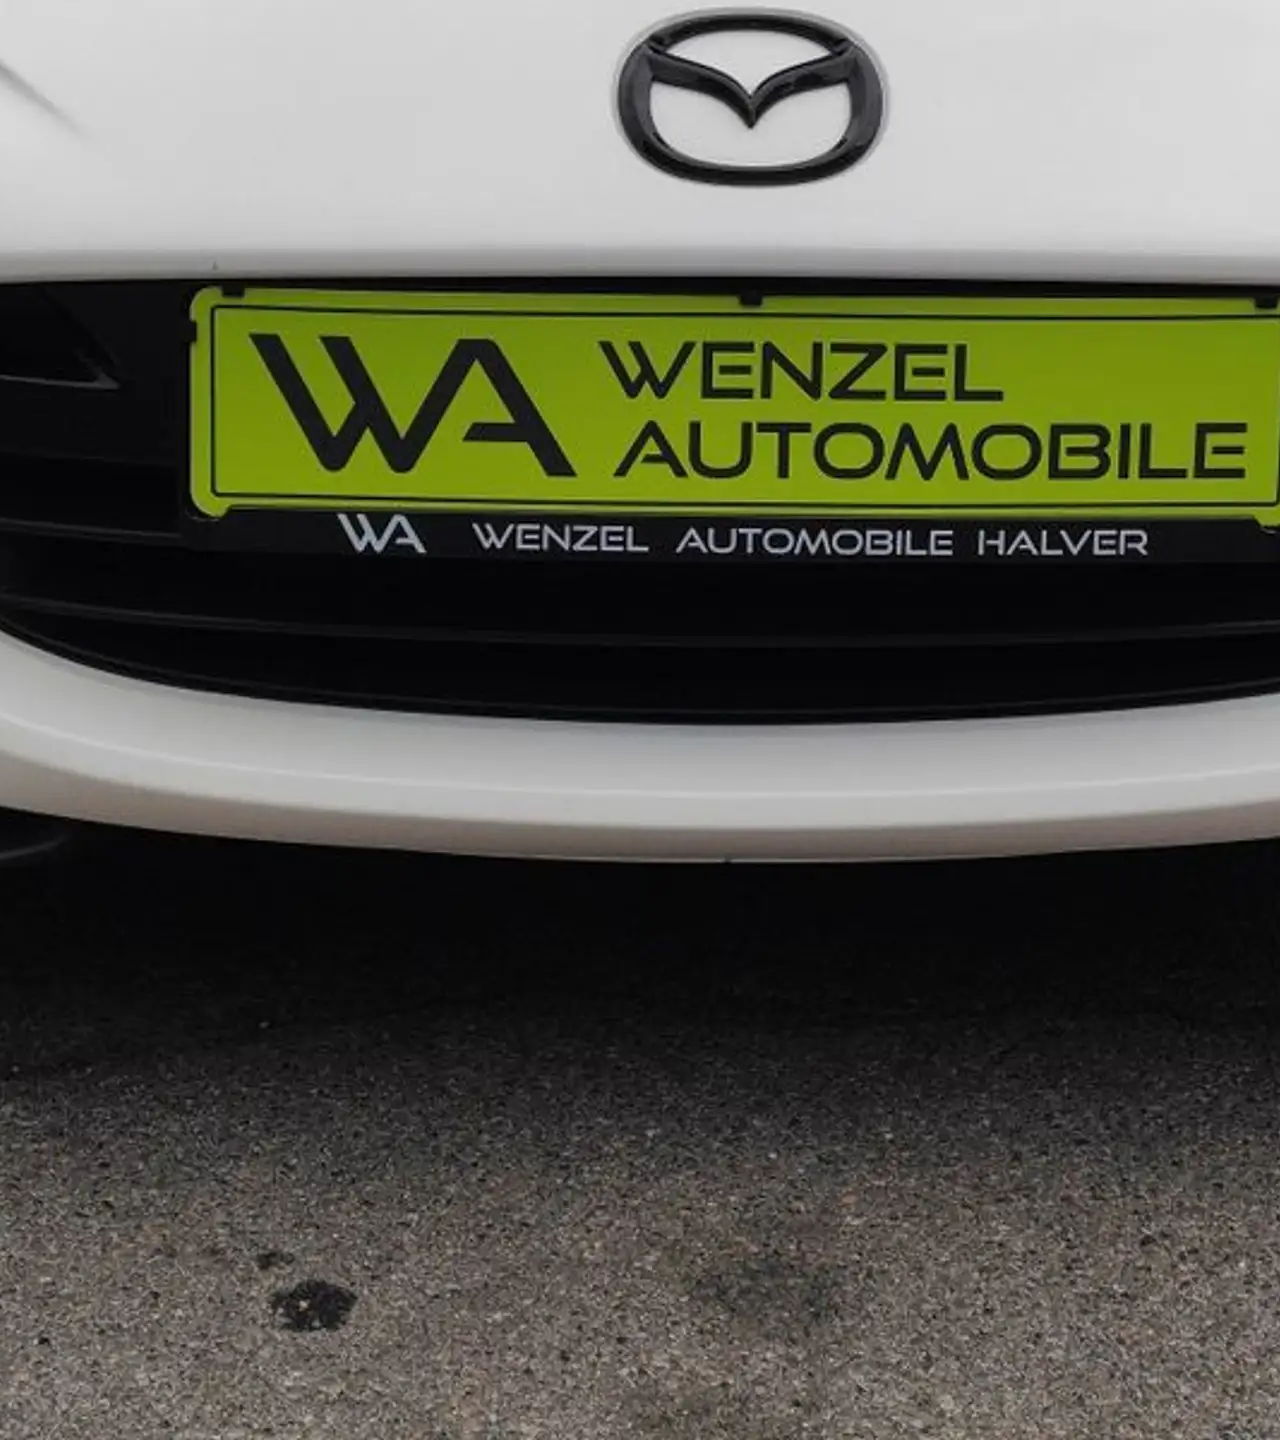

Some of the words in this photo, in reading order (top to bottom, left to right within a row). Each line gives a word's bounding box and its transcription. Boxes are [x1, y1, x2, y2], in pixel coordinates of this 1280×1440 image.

[597, 340, 1004, 402] WENZEL
[248, 333, 578, 477] WA
[612, 419, 1248, 481] AUTOMOBILE
[337, 513, 427, 554] WA
[472, 522, 650, 553] WENZEL
[676, 525, 954, 556] AUTOMOBILE
[977, 529, 1149, 556] HALVER
